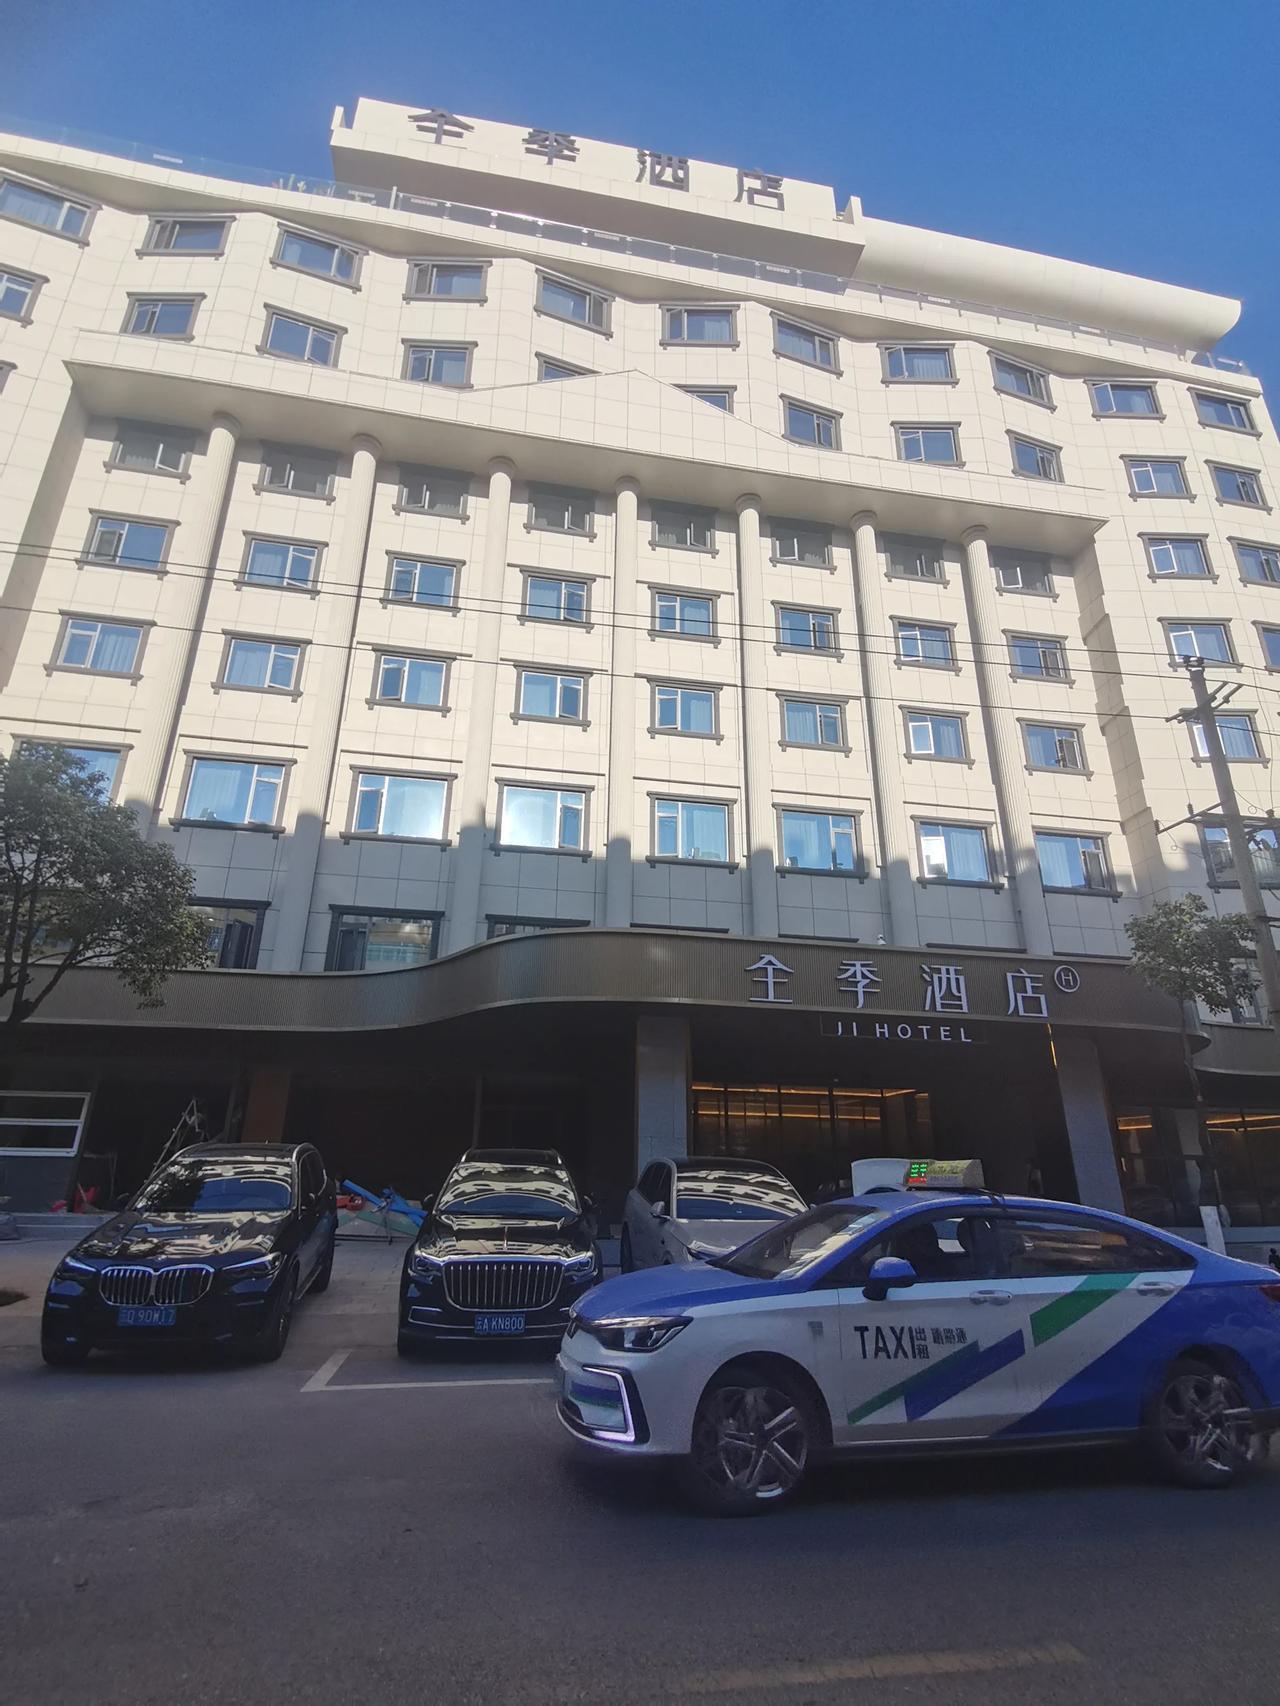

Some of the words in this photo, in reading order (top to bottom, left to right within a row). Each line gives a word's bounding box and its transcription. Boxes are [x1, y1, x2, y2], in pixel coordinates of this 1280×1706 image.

[745, 954, 1048, 1018] 全季酒店
[836, 1021, 857, 1036] JI
[875, 1022, 972, 1042] HOTEL
[854, 1326, 916, 1359] TAXI
